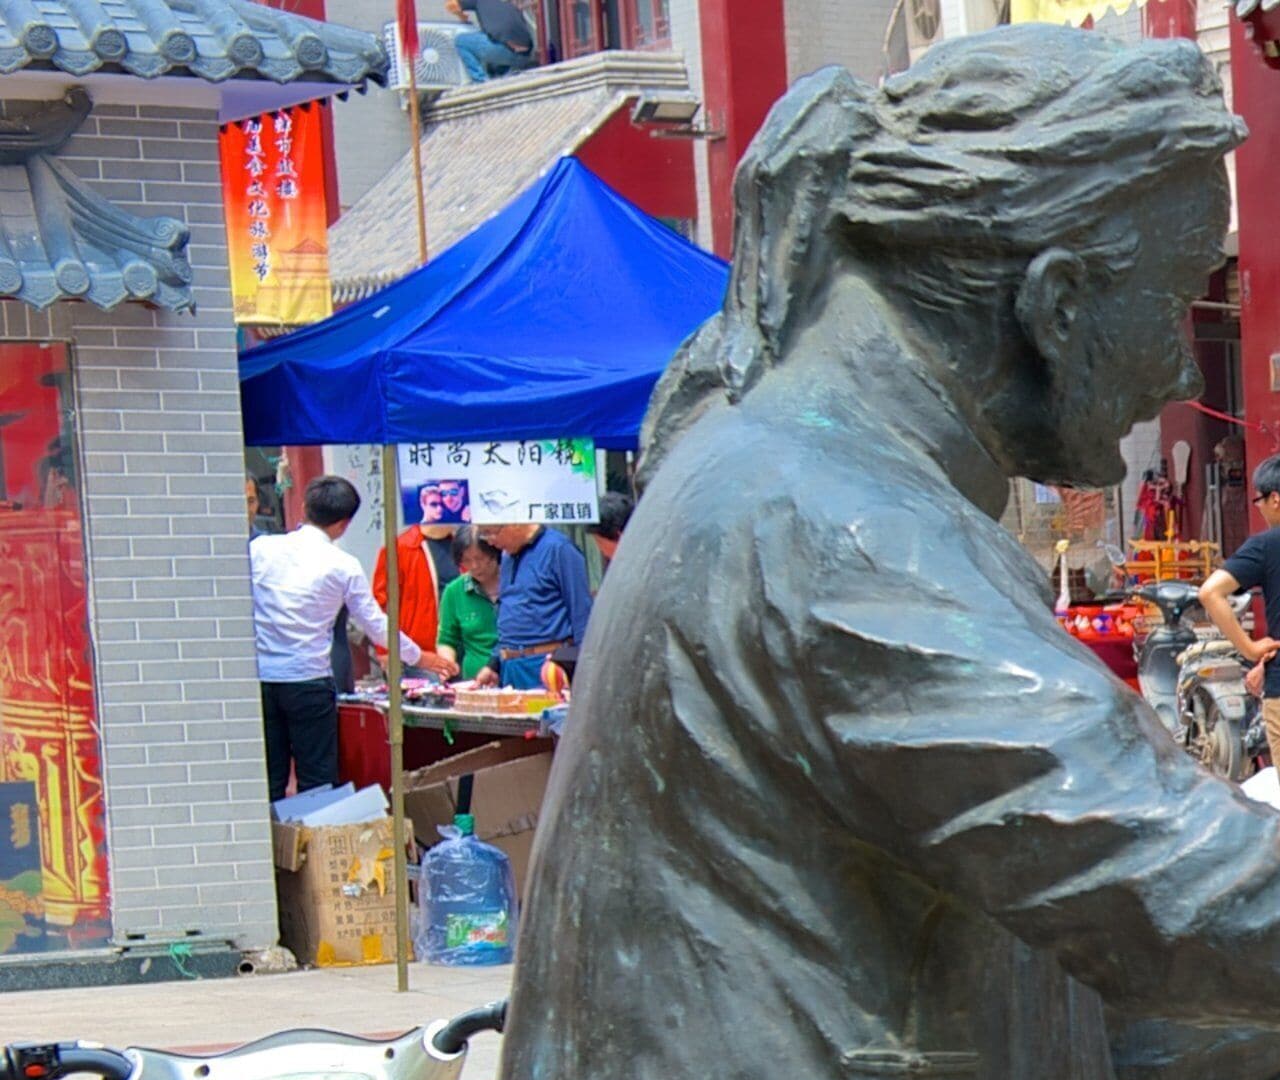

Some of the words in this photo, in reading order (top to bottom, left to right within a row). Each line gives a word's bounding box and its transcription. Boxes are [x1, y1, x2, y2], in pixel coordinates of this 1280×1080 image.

[409, 442, 582, 467] 时尚太阳镜
[528, 502, 592, 520] 厂家直销
